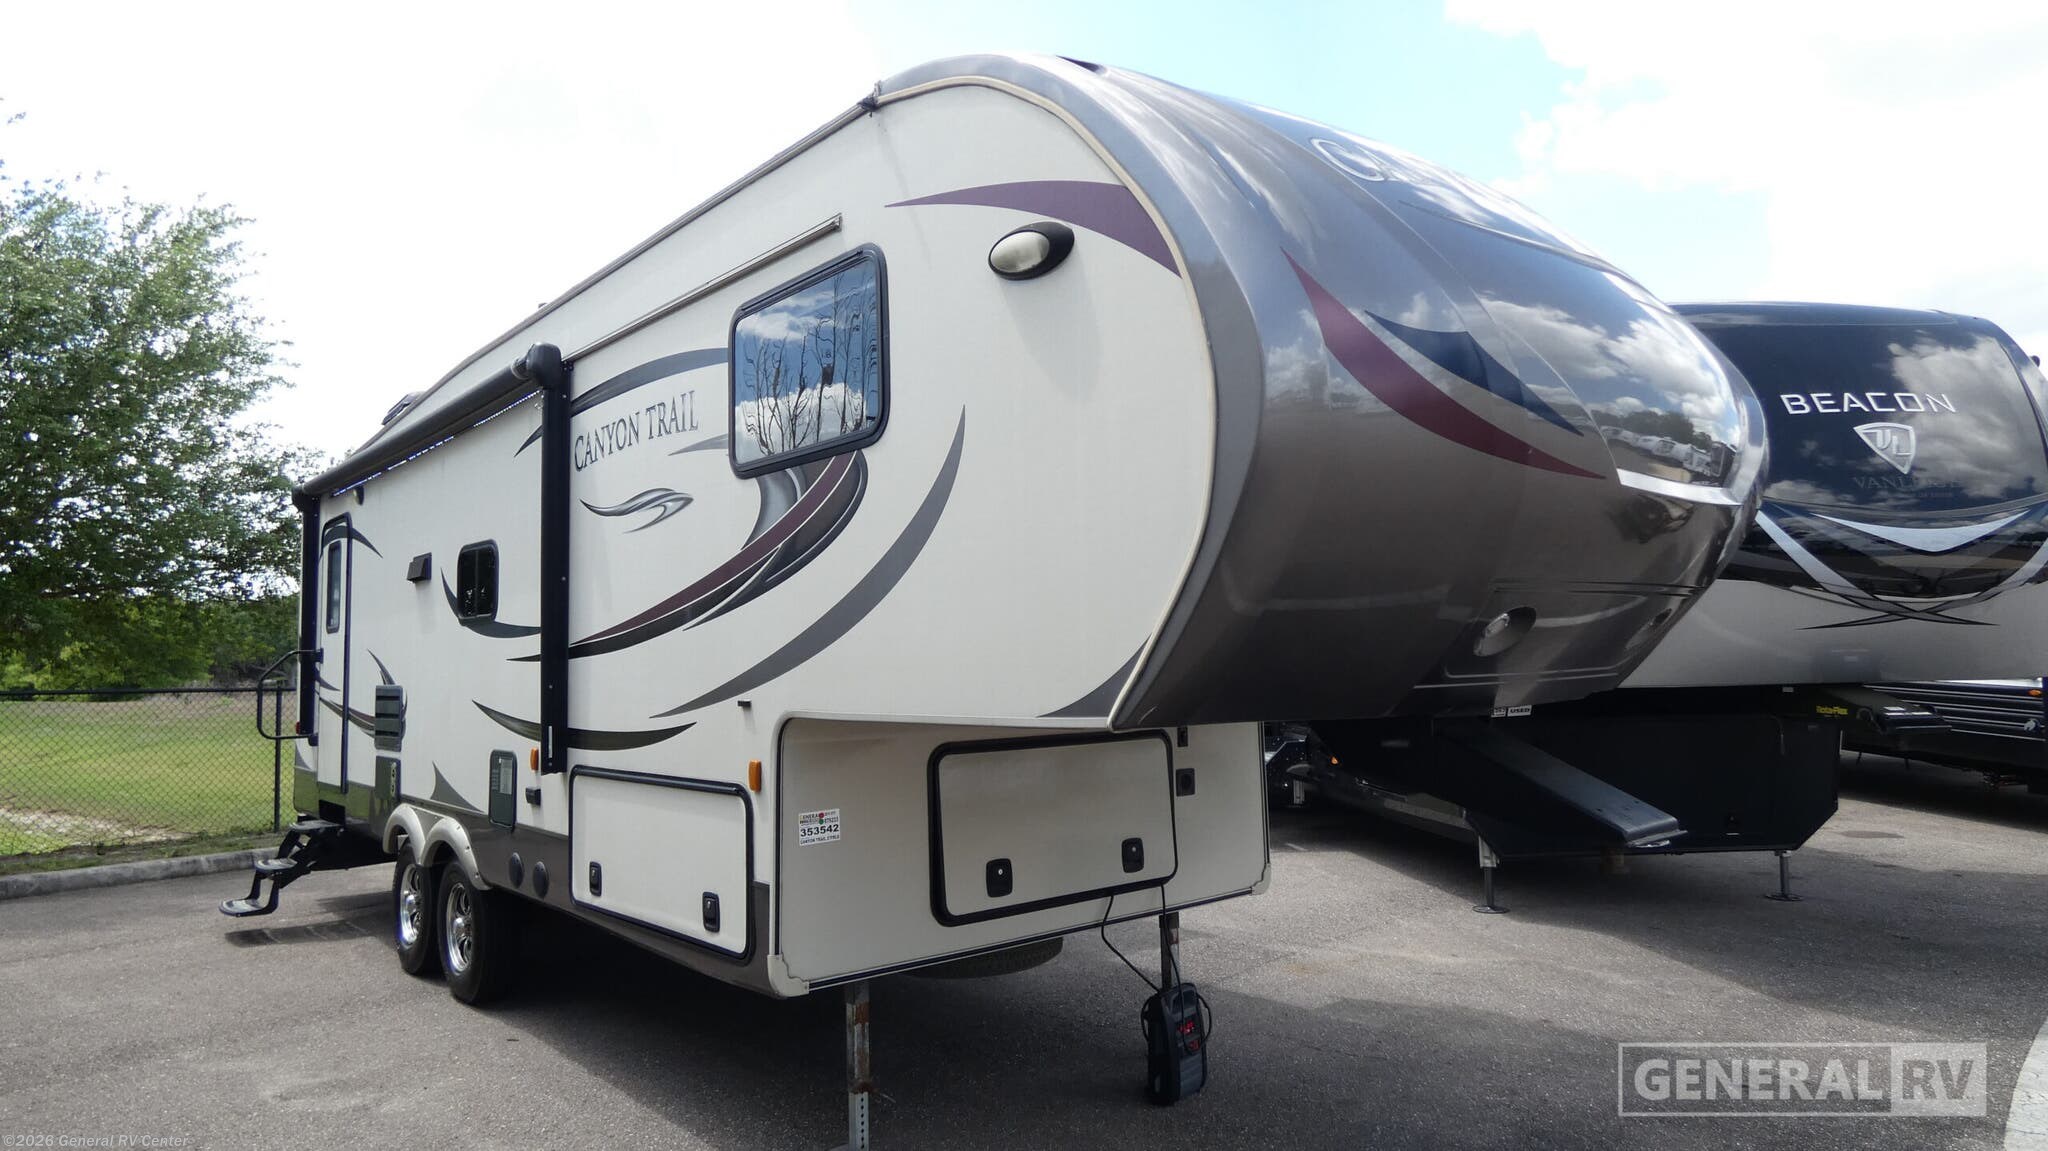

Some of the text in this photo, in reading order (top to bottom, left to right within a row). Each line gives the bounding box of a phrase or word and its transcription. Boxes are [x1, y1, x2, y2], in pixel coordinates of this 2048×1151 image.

[1780, 392, 1956, 414] BEACON
[574, 390, 699, 472] CANYON TRAIL
[800, 824, 839, 837] 353542
